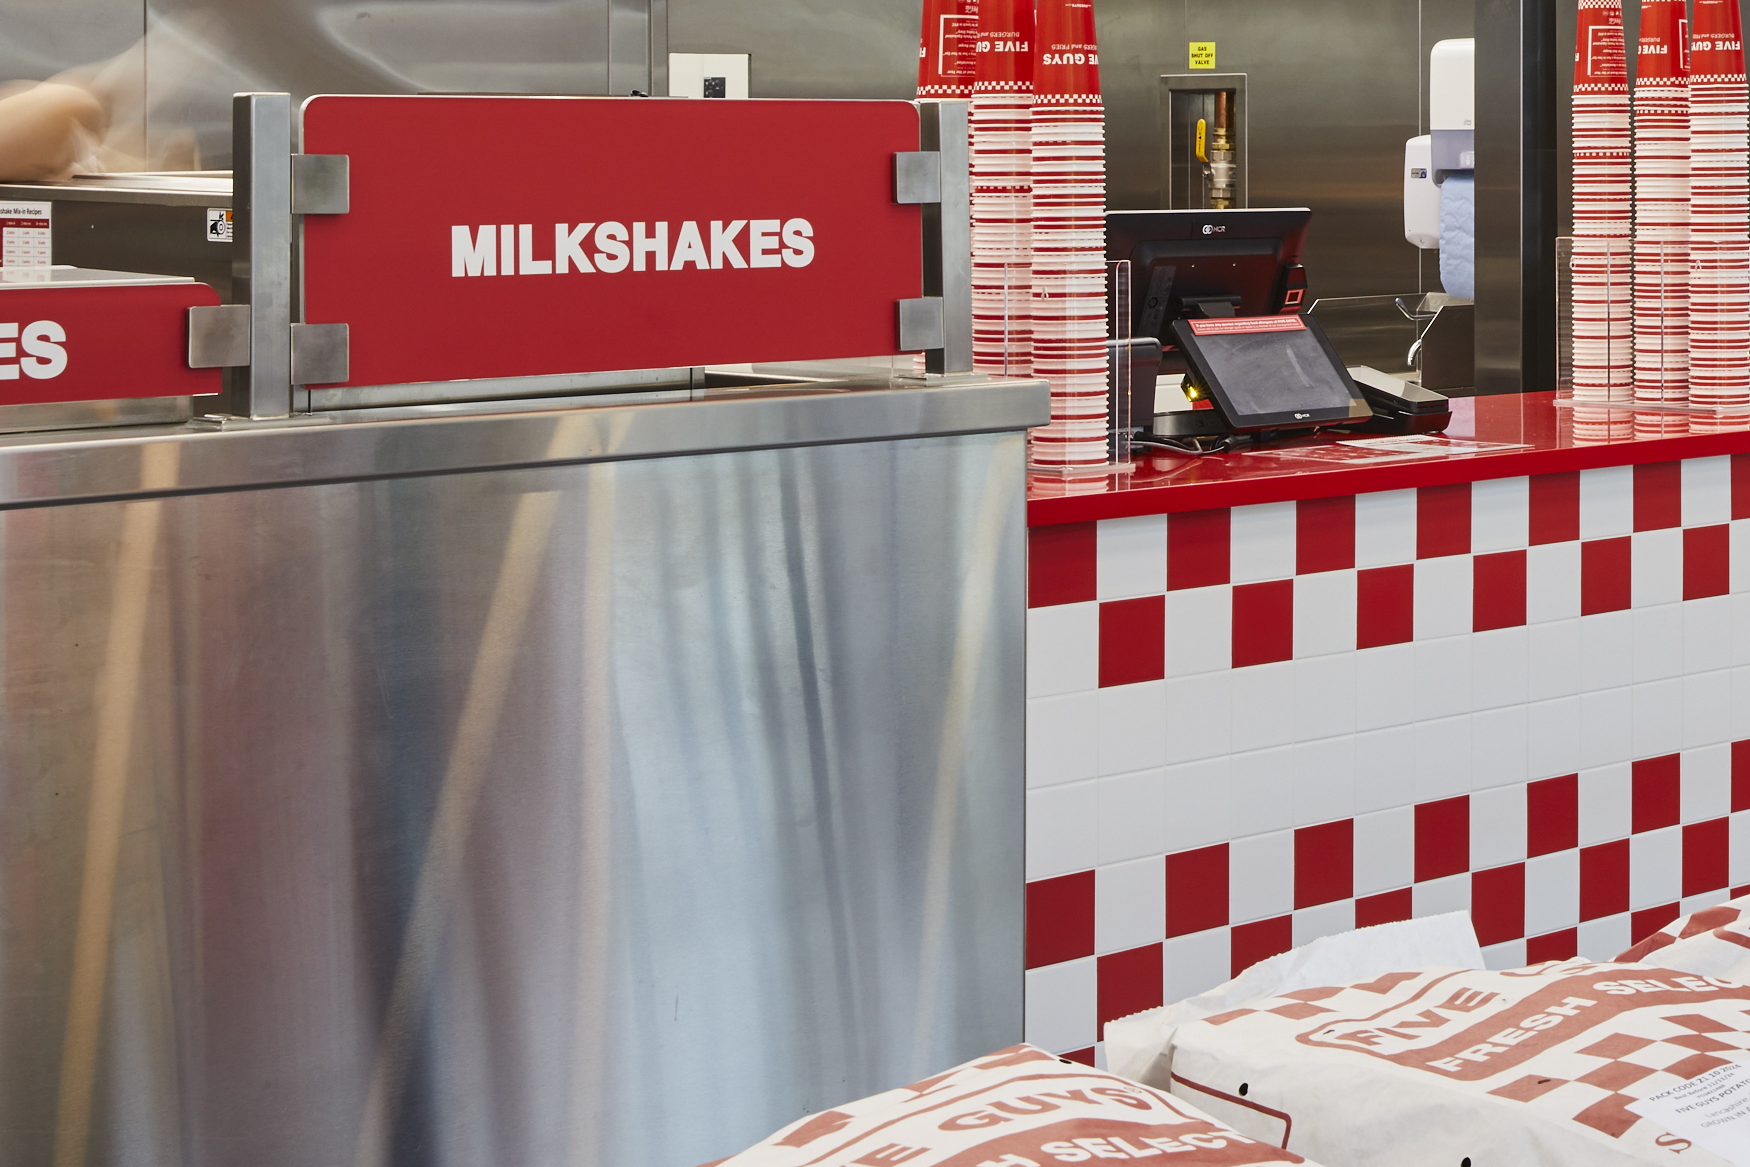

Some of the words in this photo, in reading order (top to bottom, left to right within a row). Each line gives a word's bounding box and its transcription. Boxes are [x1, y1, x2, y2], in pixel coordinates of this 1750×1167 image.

[1714, 40, 1741, 51] FIVE
[451, 218, 816, 278] MILKSHAKES
[1426, 996, 1598, 1072] FRESH
